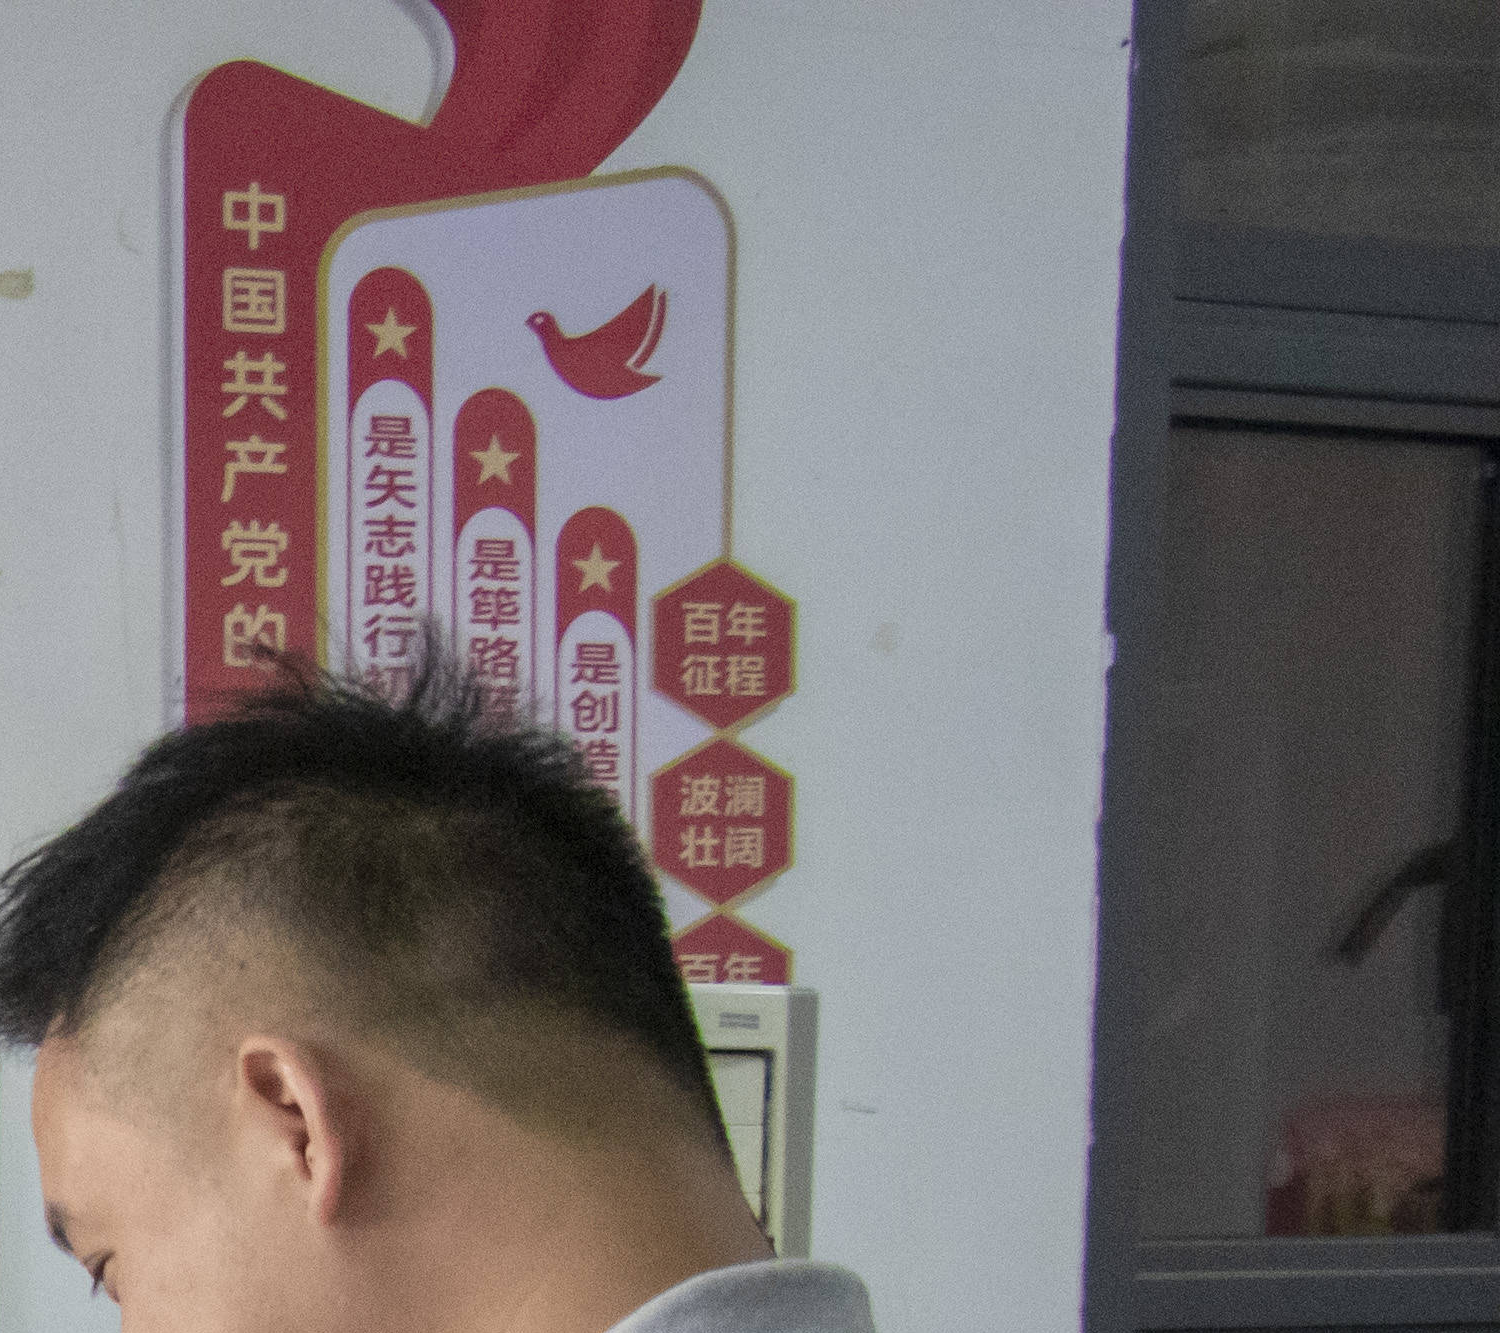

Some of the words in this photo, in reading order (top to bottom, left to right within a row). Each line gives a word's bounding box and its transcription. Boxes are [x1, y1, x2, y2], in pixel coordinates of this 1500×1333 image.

[682, 601, 767, 645] 百年
[679, 653, 767, 697] 征程
[679, 774, 766, 818] 波澜
[678, 825, 766, 869] 壮阔
